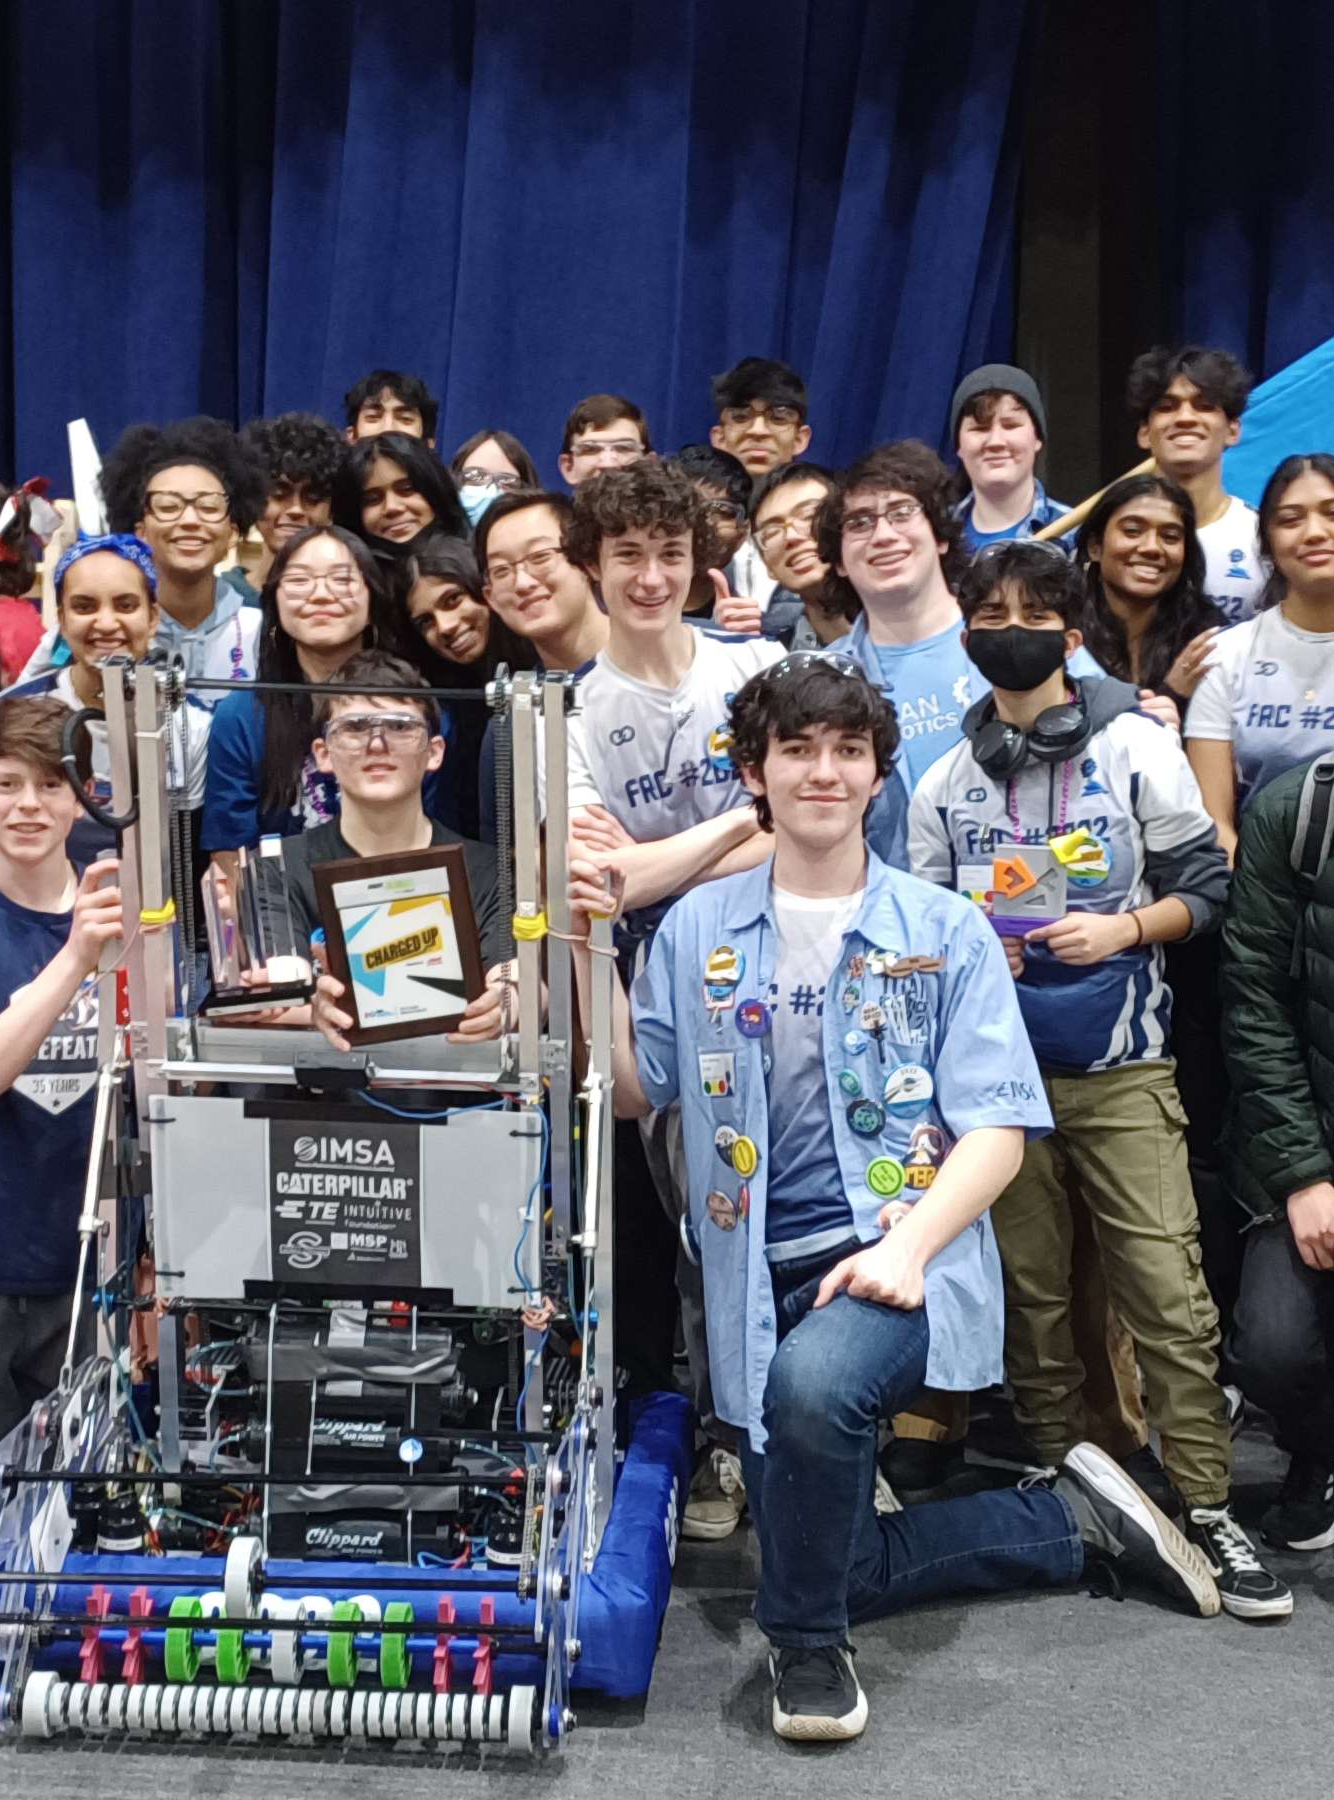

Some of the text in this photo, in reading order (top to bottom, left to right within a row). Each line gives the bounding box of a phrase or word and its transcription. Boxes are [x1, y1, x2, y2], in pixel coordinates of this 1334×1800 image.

[900, 711, 959, 740] OTICS
[1246, 703, 1292, 728] FRC
[624, 768, 673, 808] FRC
[365, 926, 439, 970] CHARGED UP
[320, 1136, 395, 1165] IMSA
[276, 1172, 408, 1200] CATERPILLAR
[308, 1201, 340, 1220] TE
[343, 1201, 412, 1221] INTUITIVE
[350, 1233, 388, 1248] MSP
[305, 1527, 384, 1549] Clippard
